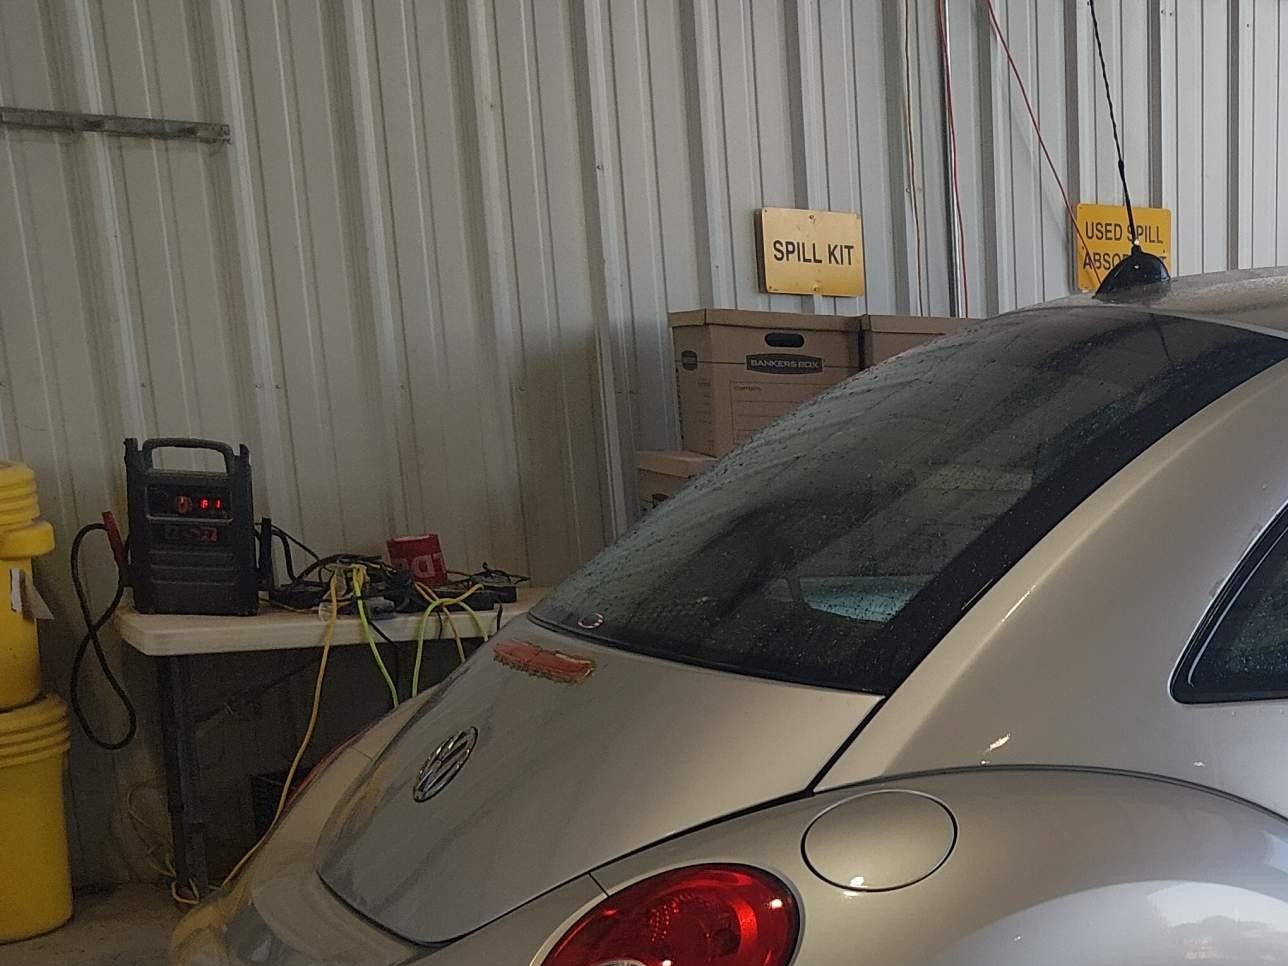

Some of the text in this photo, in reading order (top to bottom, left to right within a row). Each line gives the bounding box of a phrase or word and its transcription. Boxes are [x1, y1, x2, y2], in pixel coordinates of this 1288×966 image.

[1085, 221, 1164, 244] USED SPILL
[773, 239, 854, 266] SPILL KIT
[751, 359, 819, 369] BANKERS BOX
